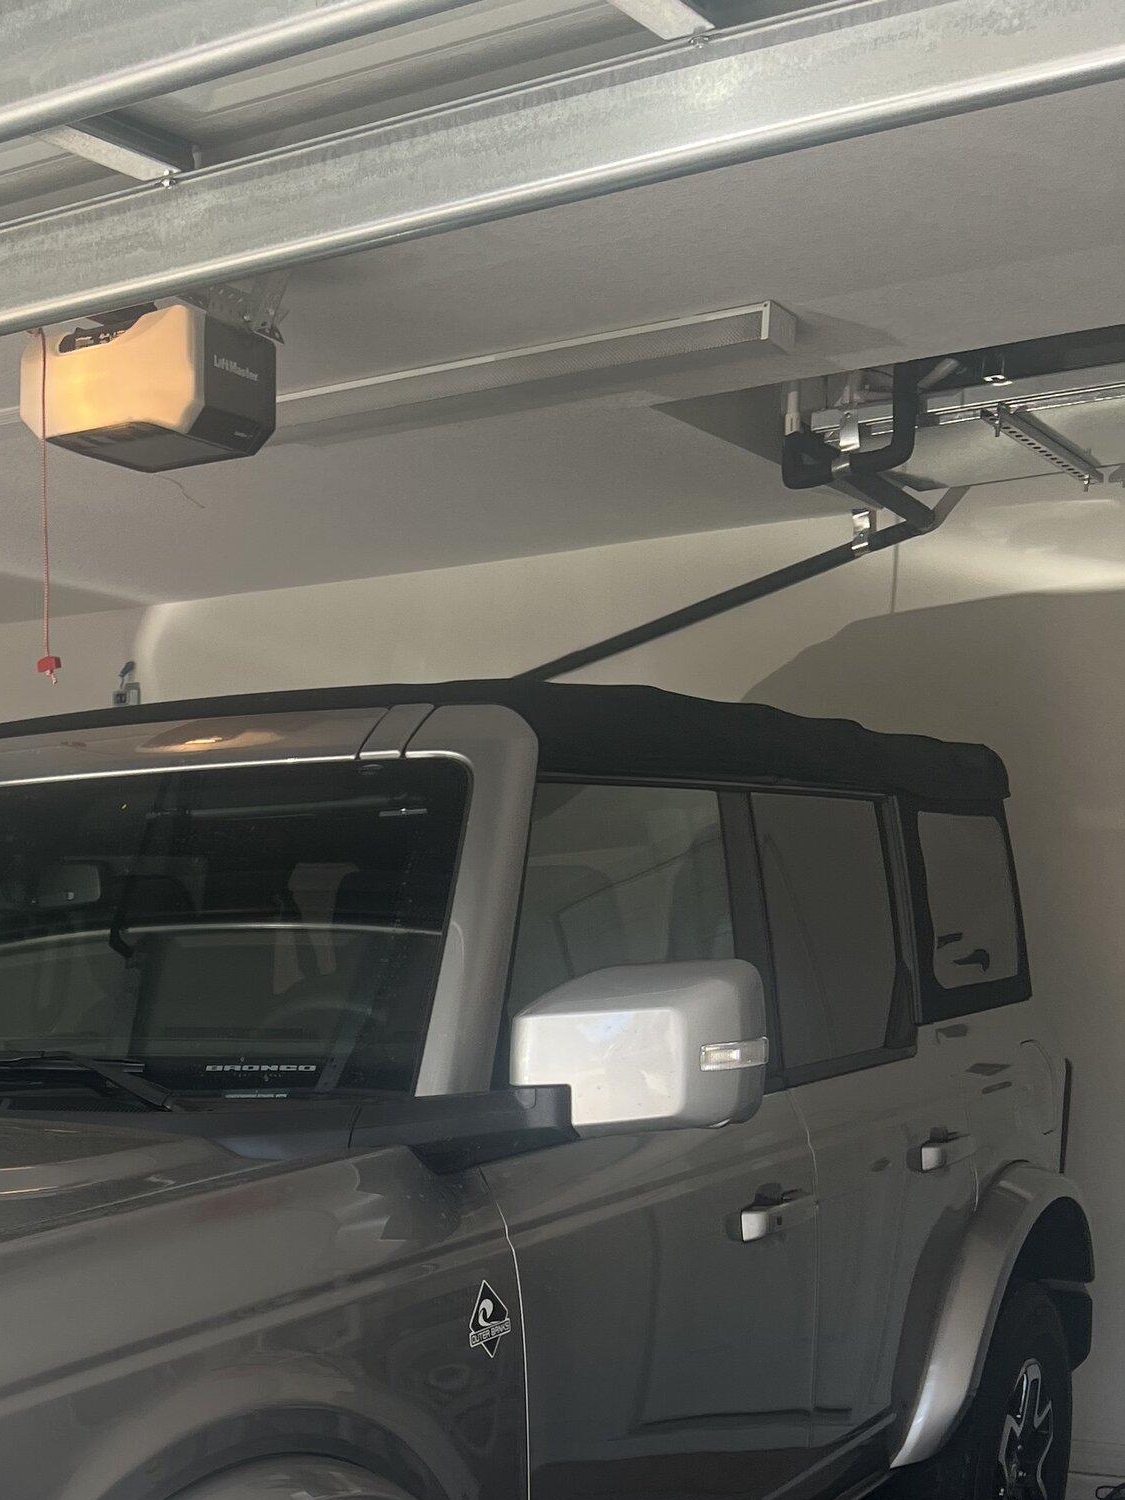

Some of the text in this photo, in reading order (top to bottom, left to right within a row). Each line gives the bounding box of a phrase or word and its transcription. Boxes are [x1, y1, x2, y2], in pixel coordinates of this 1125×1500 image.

[213, 354, 259, 381] LiftMaster
[205, 1064, 317, 1072] BRONCO
[471, 1320, 510, 1344] OUTER BANKS
